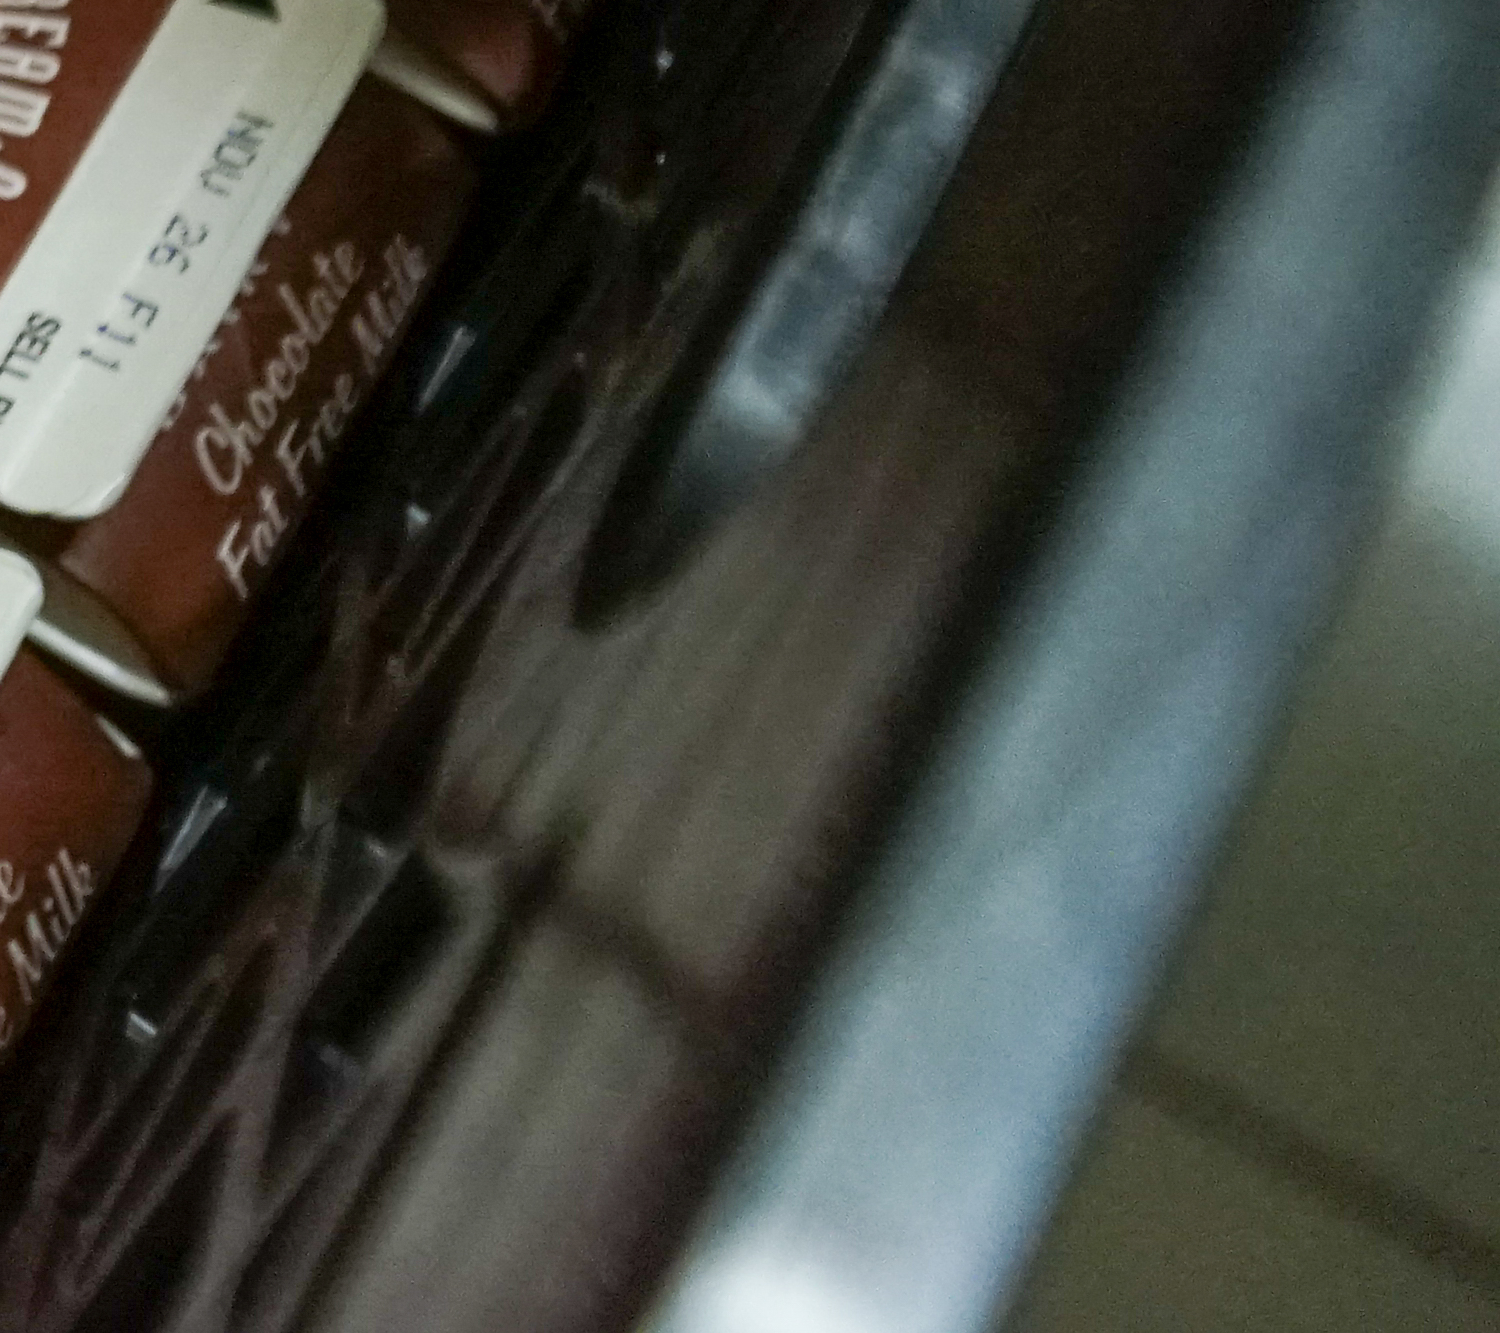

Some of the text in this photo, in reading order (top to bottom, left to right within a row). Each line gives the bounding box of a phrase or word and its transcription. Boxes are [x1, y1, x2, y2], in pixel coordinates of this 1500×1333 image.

[6, 308, 62, 393] SELL
[194, 241, 363, 497] Chocolate
[218, 505, 285, 601] Fat
[14, 846, 102, 1002] Milk
